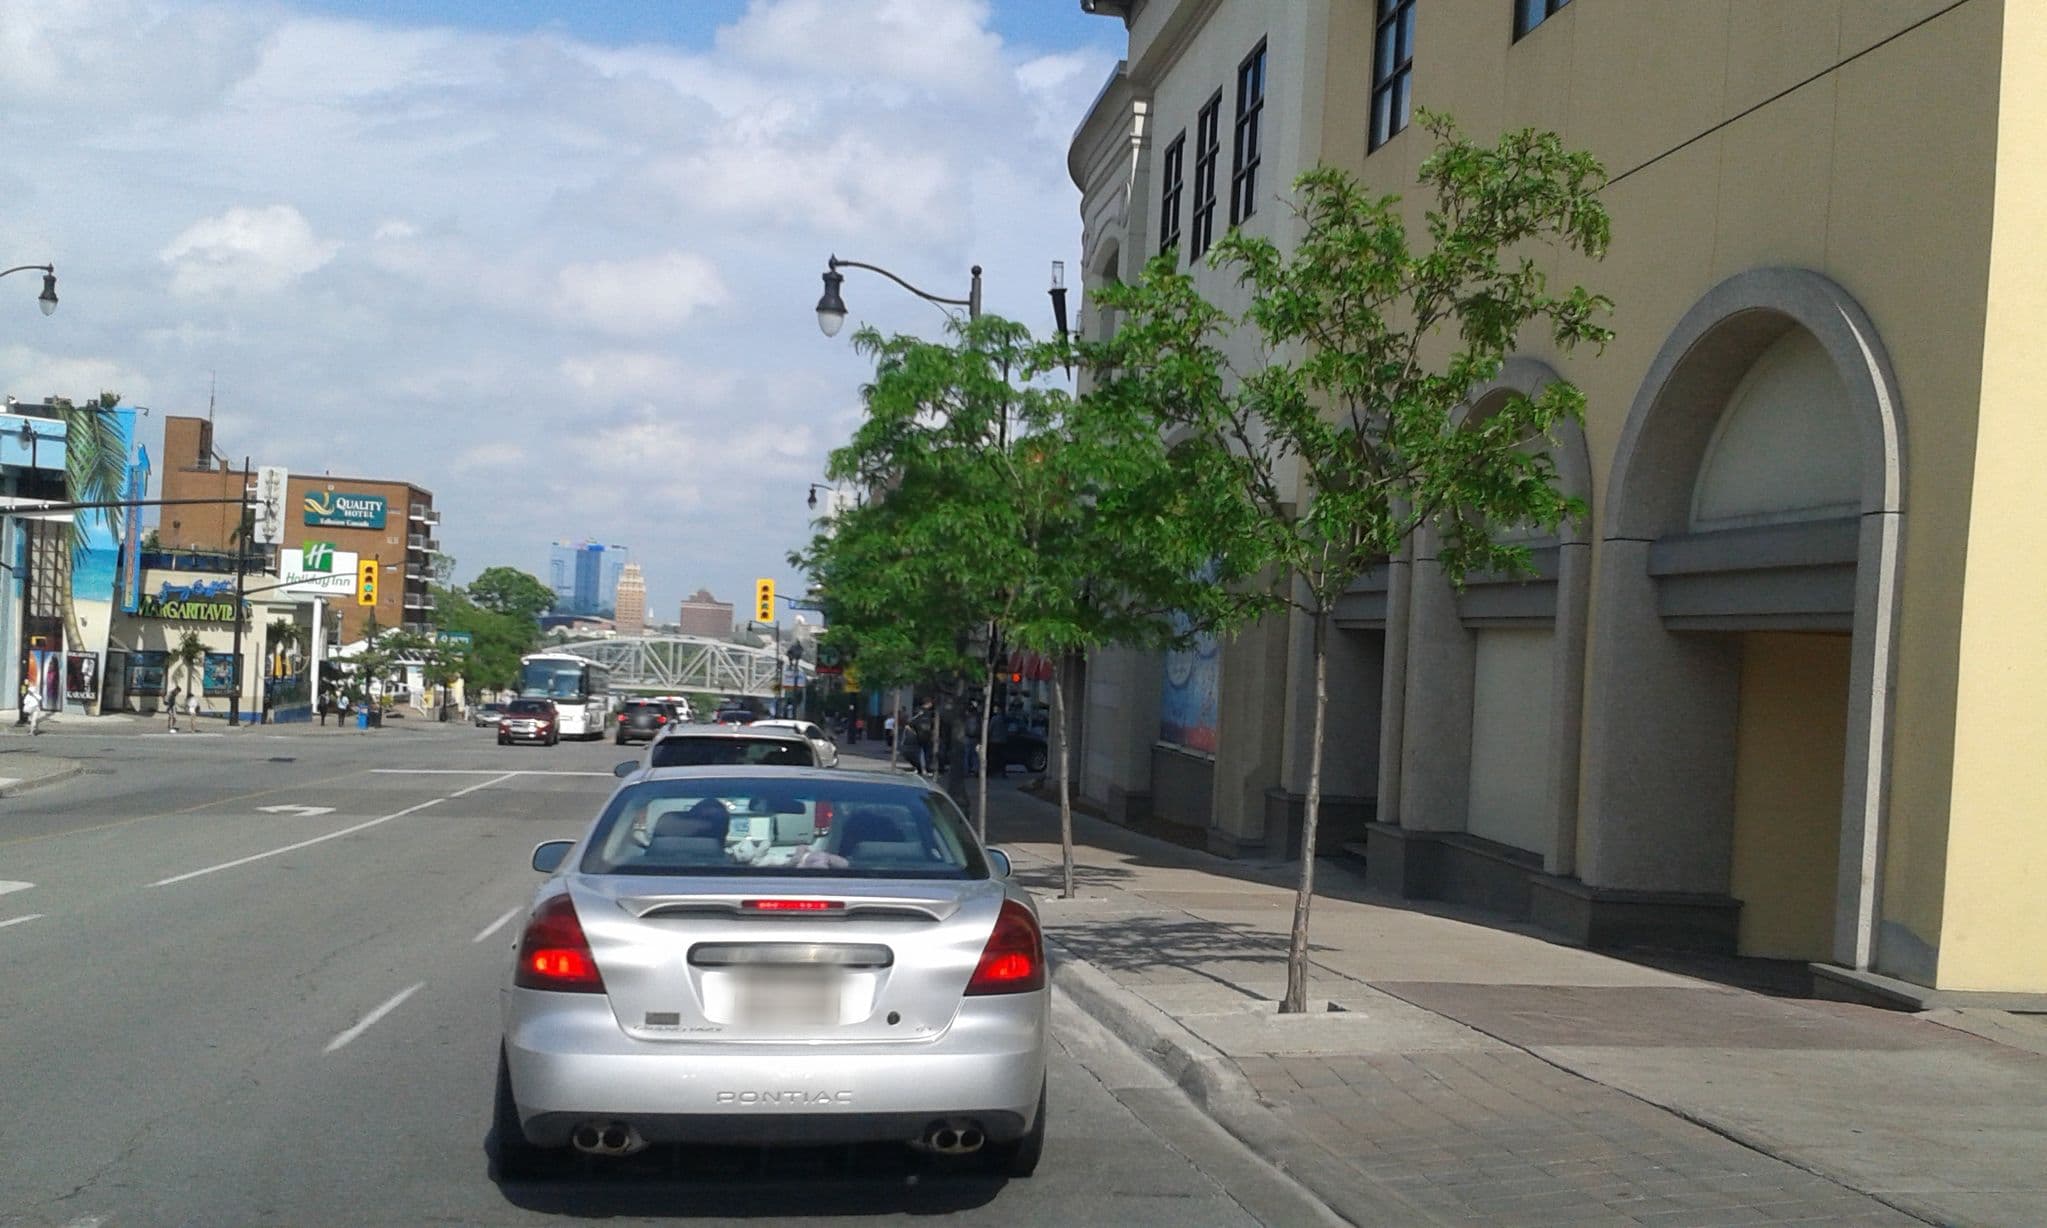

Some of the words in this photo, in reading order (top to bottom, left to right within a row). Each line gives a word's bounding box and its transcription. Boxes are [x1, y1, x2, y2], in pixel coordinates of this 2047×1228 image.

[336, 497, 383, 511] QUALITY
[344, 509, 375, 518] HOTEL
[138, 595, 255, 622] MARGARITAVILE
[716, 1090, 853, 1104] PONTIAC
